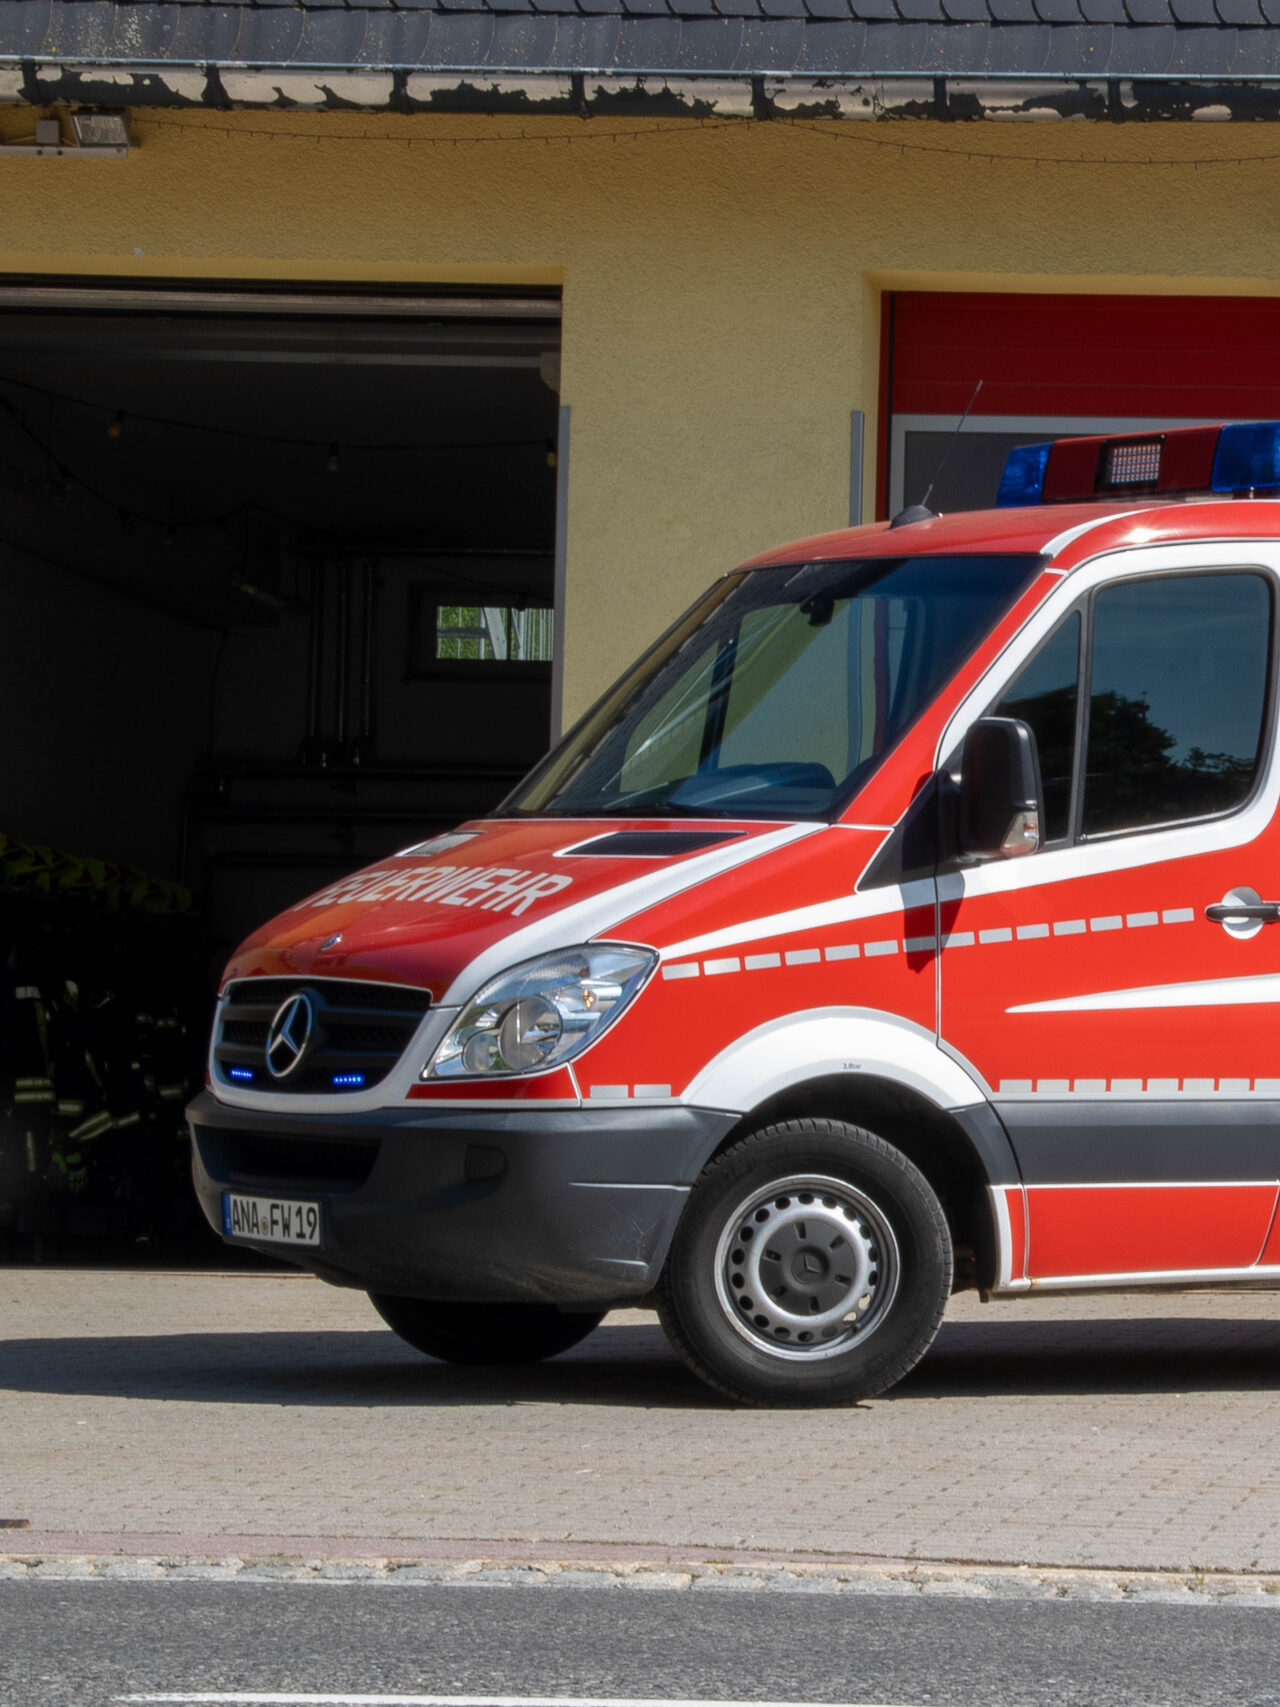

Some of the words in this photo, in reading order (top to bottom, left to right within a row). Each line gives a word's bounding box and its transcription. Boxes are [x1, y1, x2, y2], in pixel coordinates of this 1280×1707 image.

[293, 866, 573, 917] FEUERWEHR
[232, 1198, 260, 1235] ANA
[270, 1203, 292, 1238] FW
[295, 1205, 318, 1241] 19
